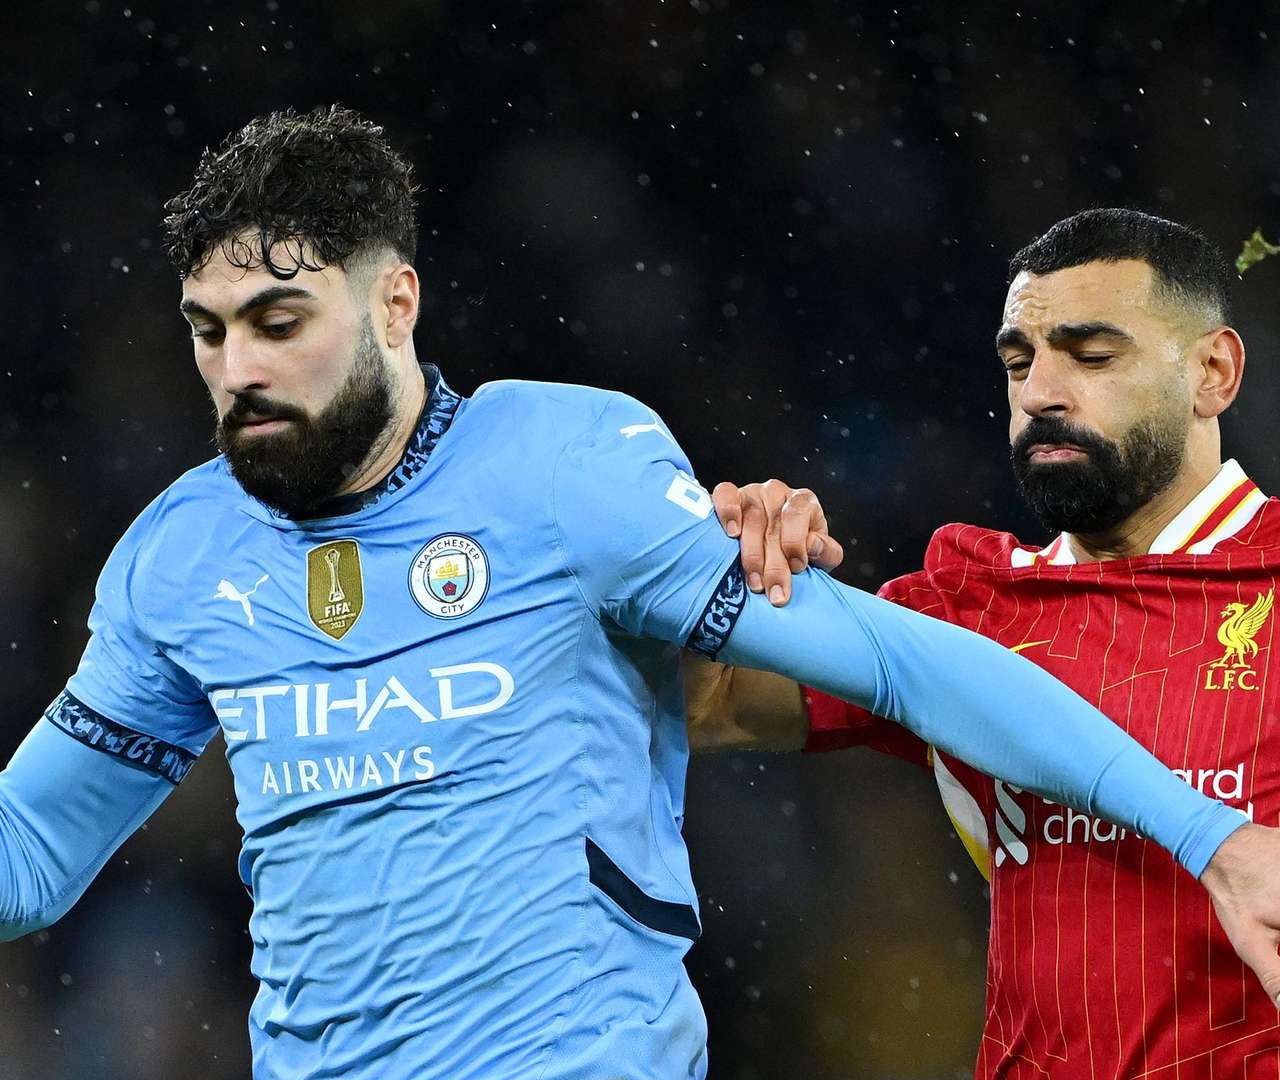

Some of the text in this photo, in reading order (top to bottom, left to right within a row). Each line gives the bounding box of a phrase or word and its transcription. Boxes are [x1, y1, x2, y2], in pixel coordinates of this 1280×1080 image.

[417, 538, 480, 569] MANCHESTER
[324, 601, 351, 618] FIFA
[440, 603, 464, 614] CITY
[1204, 669, 1260, 690] L.F.C.
[211, 662, 515, 740] ETIHAD
[261, 746, 436, 794] AIRWAYS
